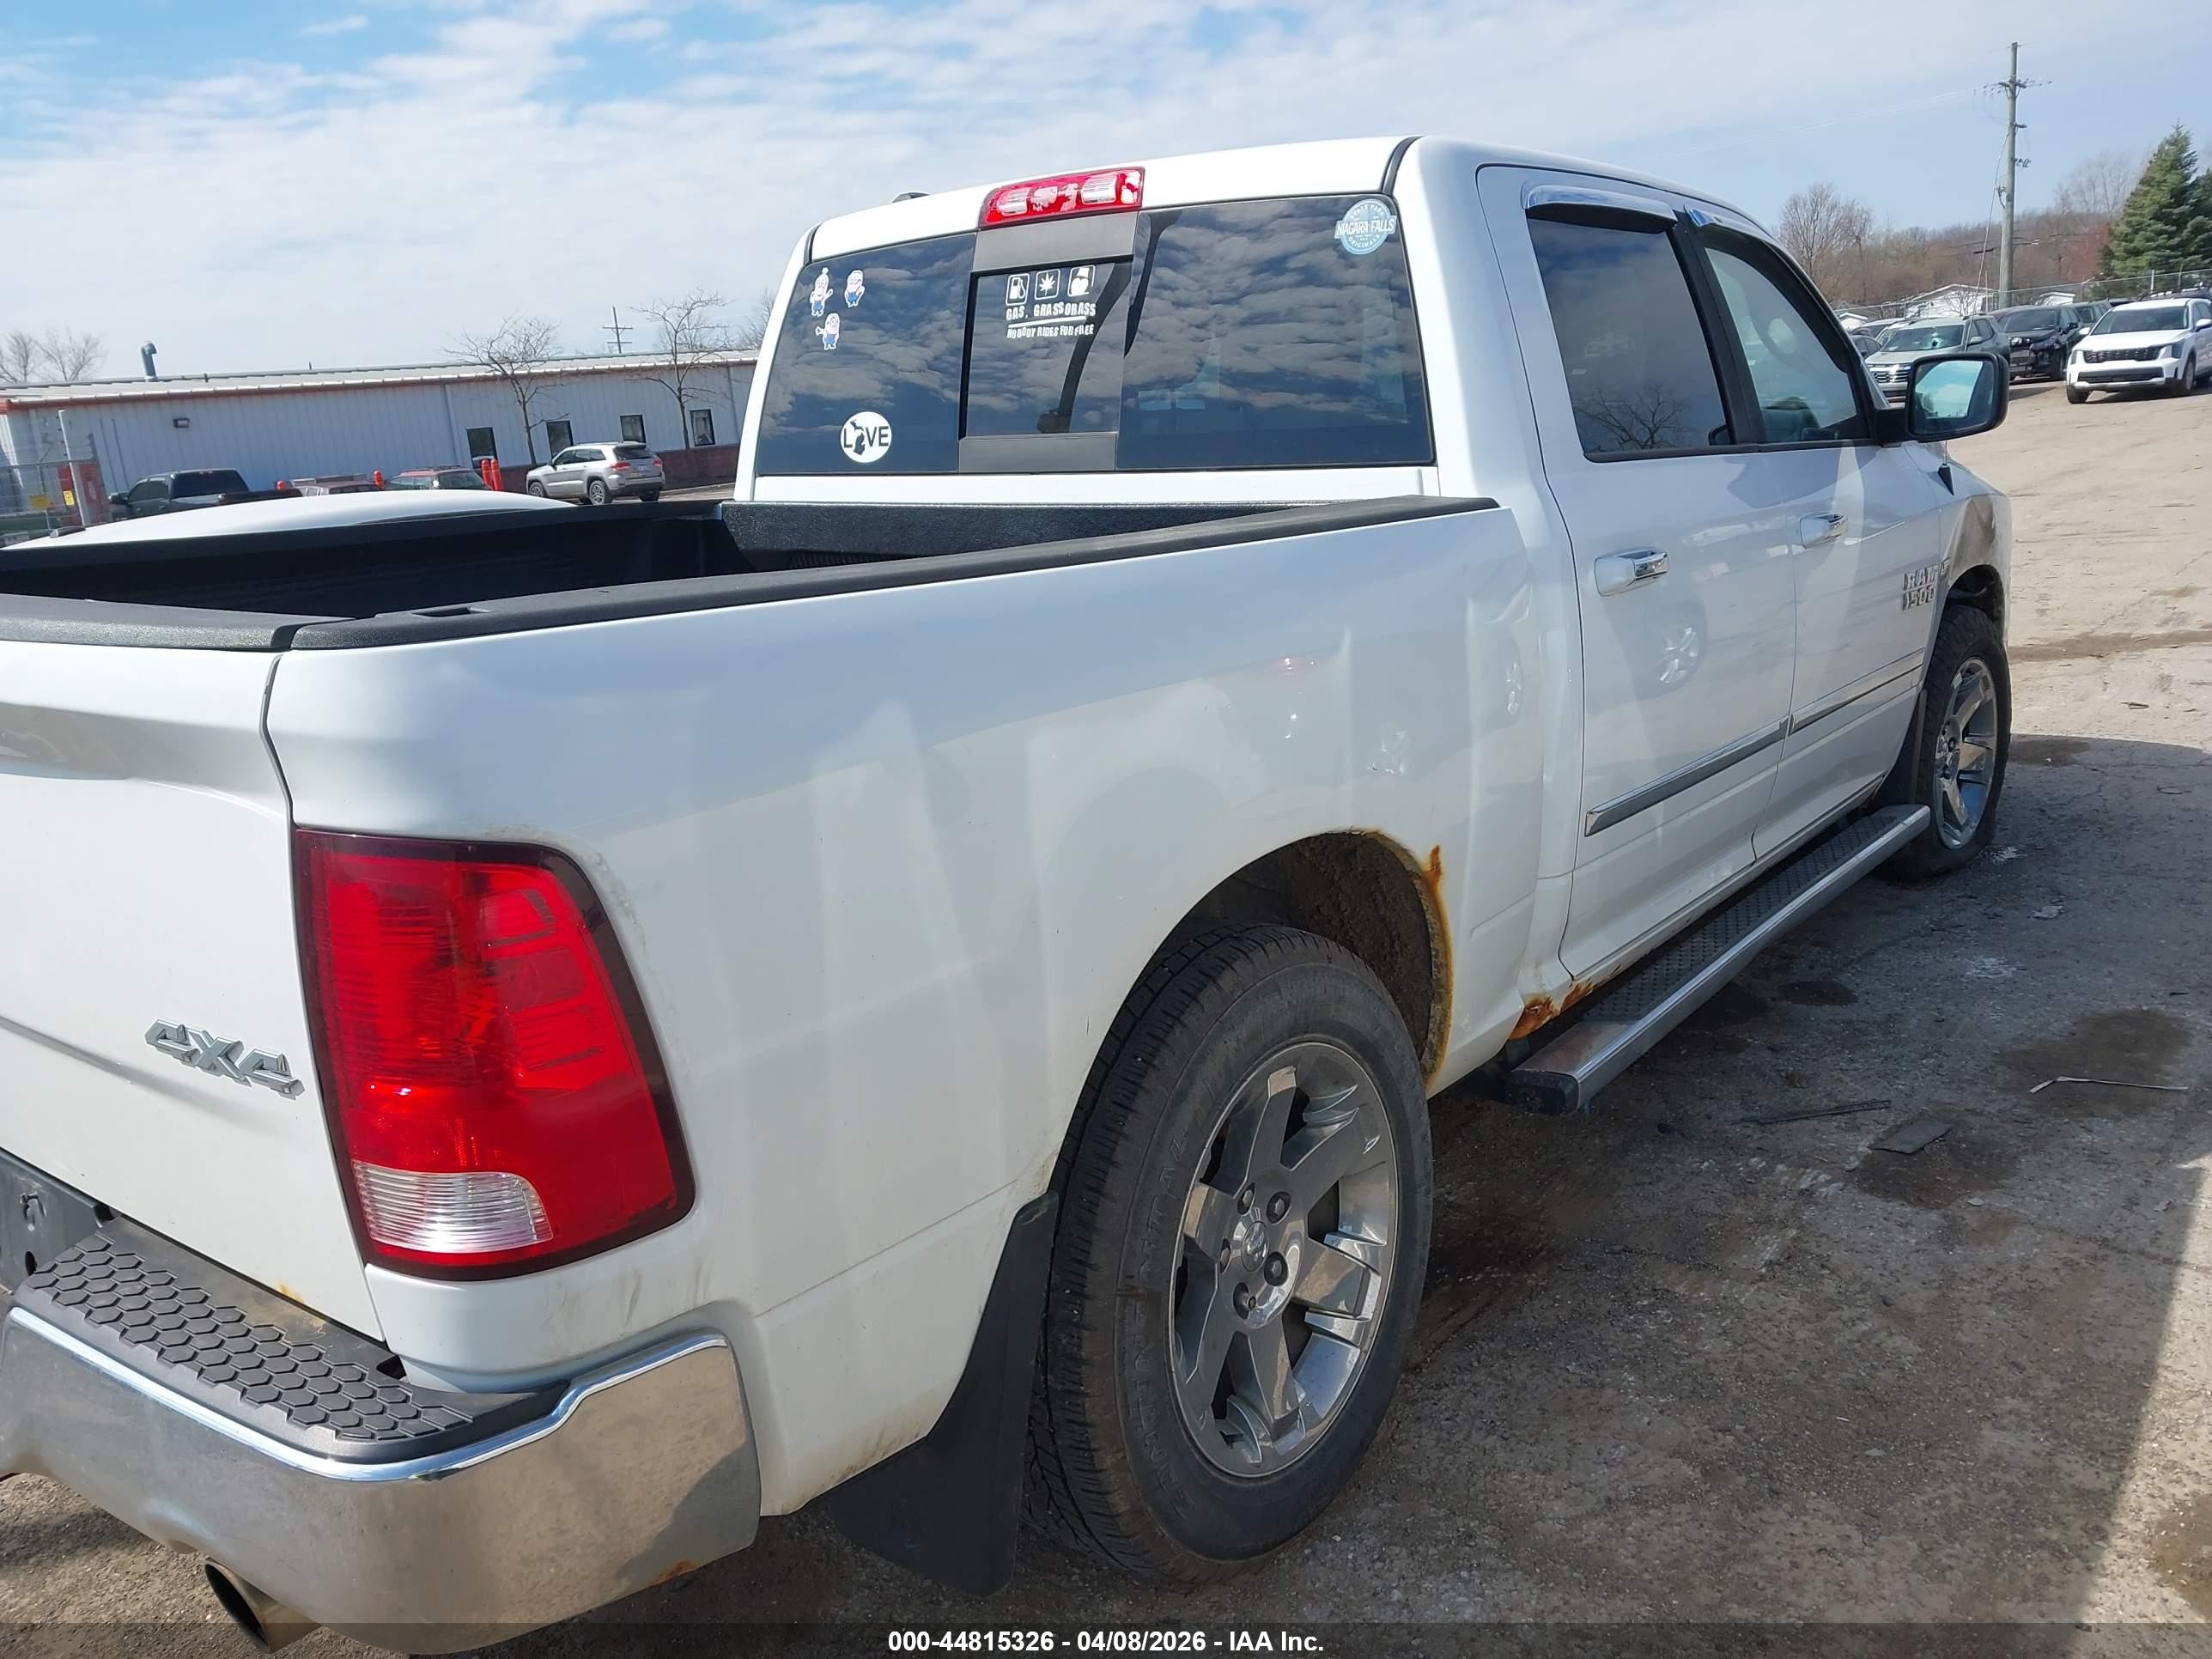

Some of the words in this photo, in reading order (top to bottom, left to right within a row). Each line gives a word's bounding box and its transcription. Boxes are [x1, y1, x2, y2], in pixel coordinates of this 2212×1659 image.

[1337, 221, 1368, 235] NIAGARA
[1370, 218, 1395, 232] FALLS
[1006, 305, 1029, 320] GAS,
[1033, 301, 1064, 317] GRASS
[1006, 326, 1036, 339] NOBODY
[1037, 326, 1060, 337] RIDES
[1059, 325, 1073, 337] FOR
[1073, 324, 1095, 337] FREE
[1903, 564, 1938, 592] RAM
[1902, 586, 1936, 611] 1500
